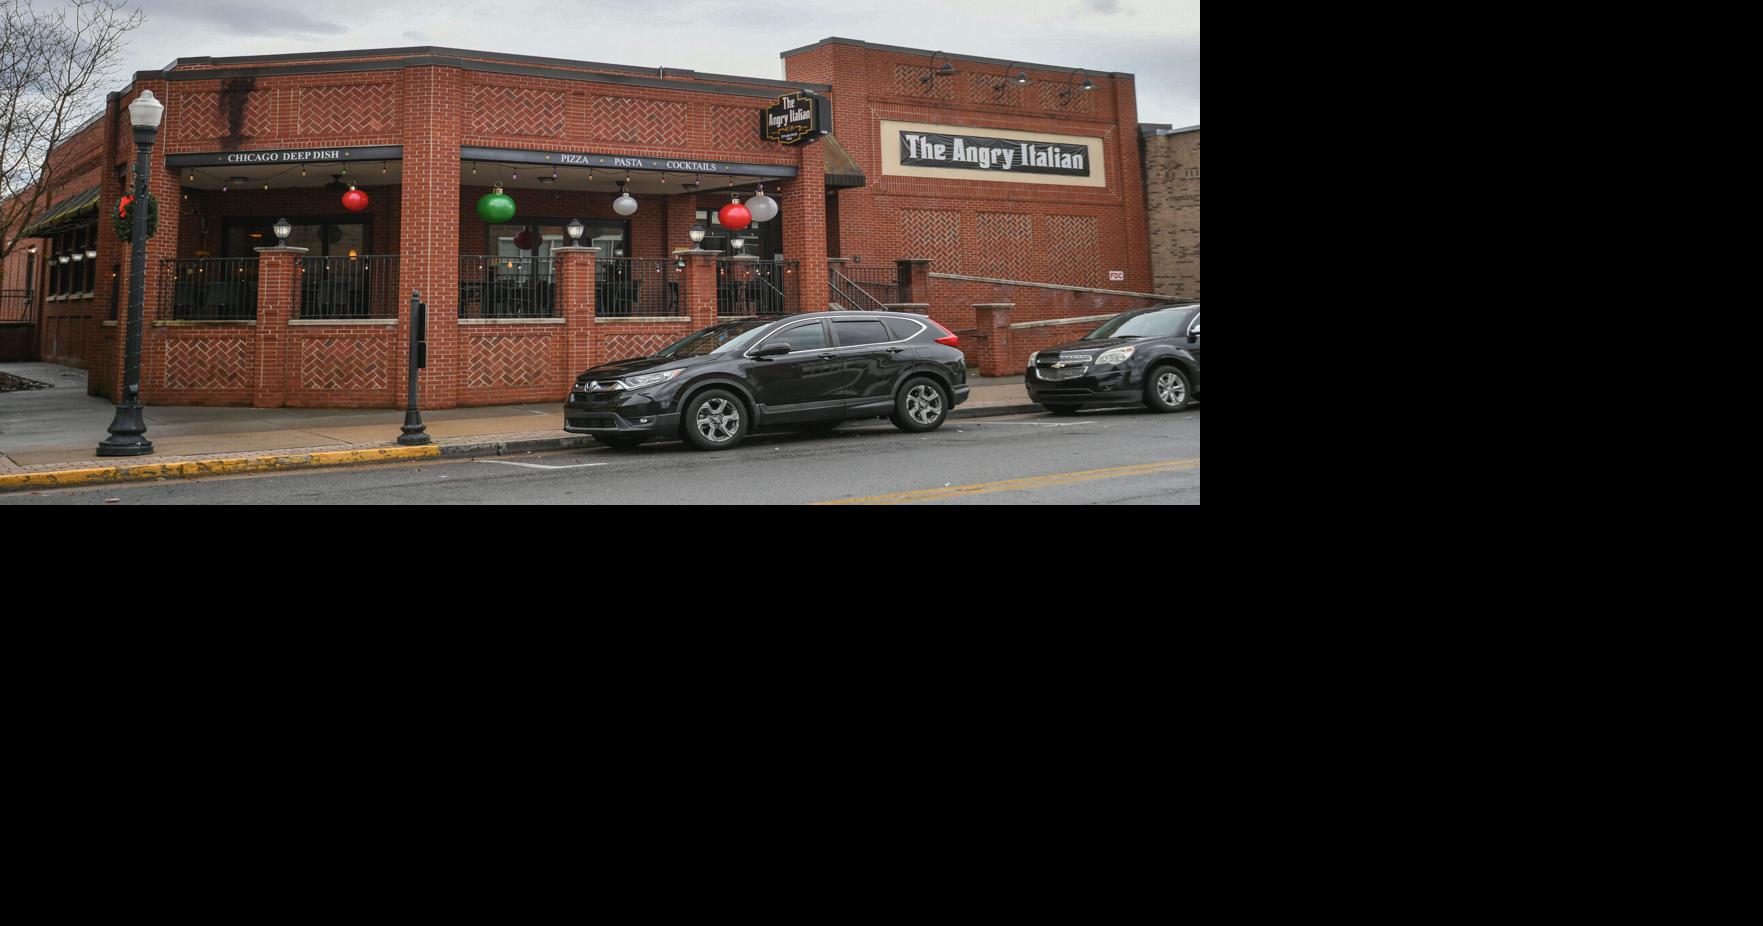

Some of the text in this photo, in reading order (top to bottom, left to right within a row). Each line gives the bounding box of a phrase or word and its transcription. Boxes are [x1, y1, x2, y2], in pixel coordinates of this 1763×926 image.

[782, 96, 795, 109] The
[768, 108, 811, 127] Angry Italian
[227, 150, 340, 163] CHICAGO DEEP DISH
[906, 134, 1084, 170] The Angry Italian
[561, 154, 717, 171] PIZZA PASTA COCKTAILS
